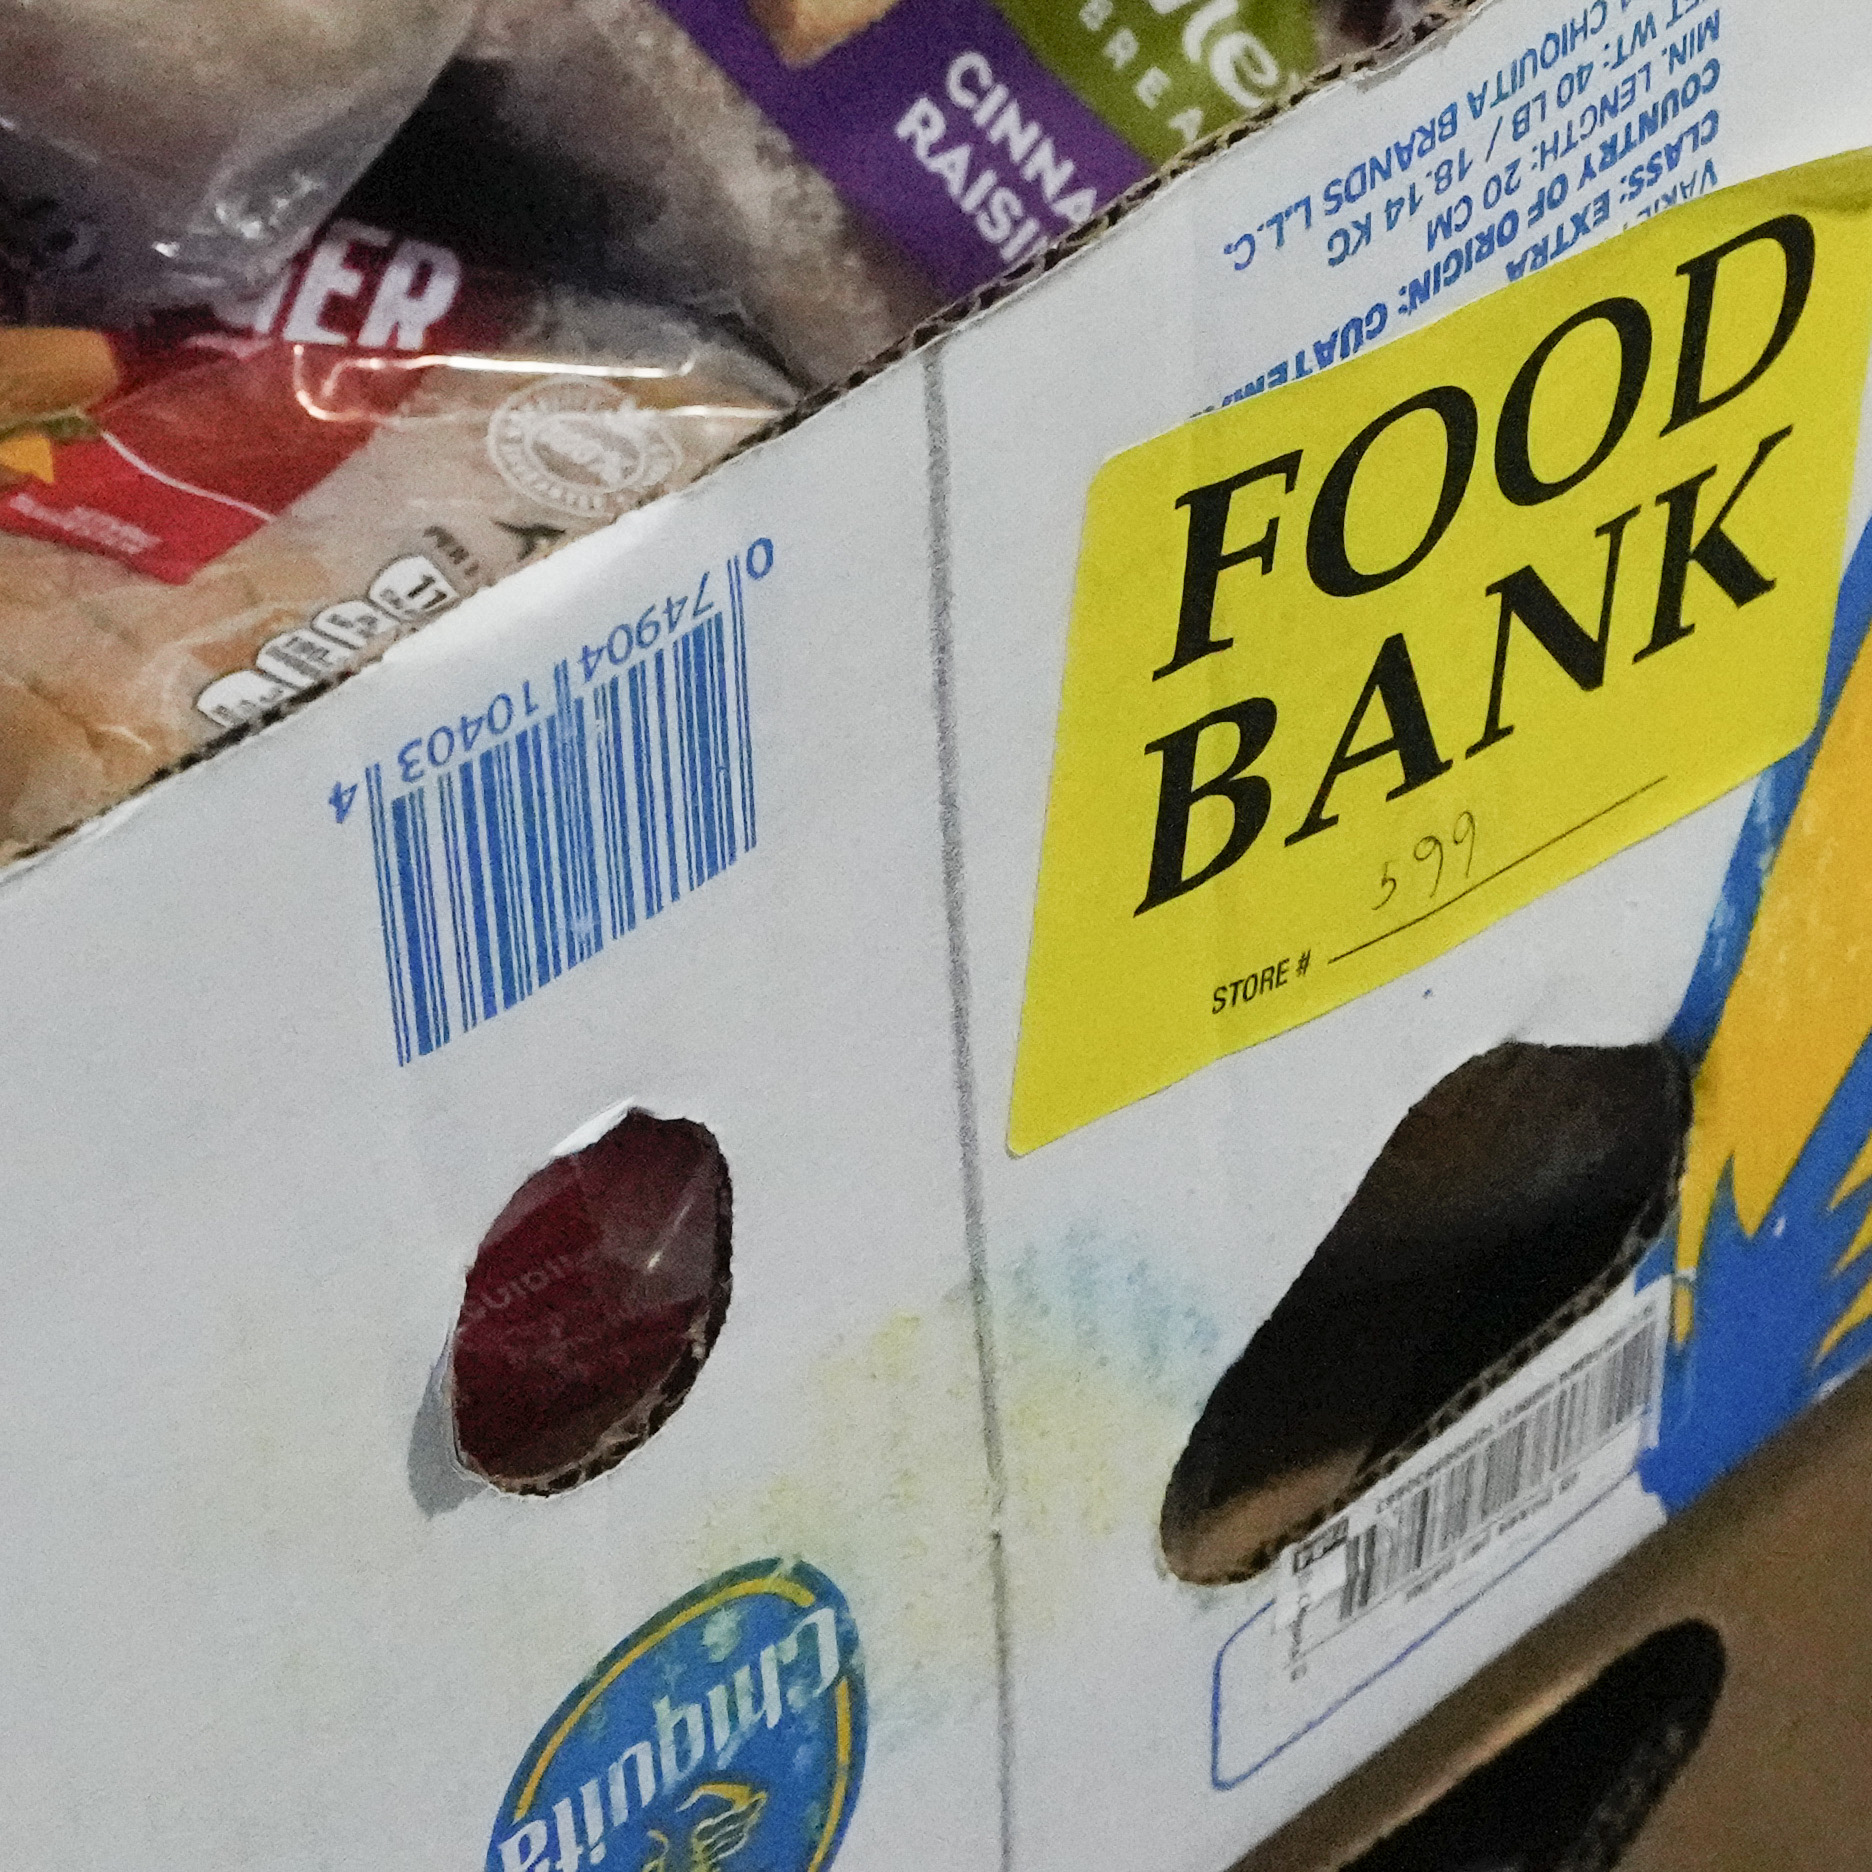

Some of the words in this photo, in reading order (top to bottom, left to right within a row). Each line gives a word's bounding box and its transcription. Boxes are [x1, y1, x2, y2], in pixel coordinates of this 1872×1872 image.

[1555, 67, 1597, 111] 40
[1602, 14, 1660, 72] WT:
[1664, 8, 1723, 78] MIN.
[943, 49, 1100, 231] CINNA
[1321, 102, 1459, 213] BRANDS
[1509, 89, 1549, 144] LB
[1532, 65, 1656, 168] LENGTH:
[1575, 57, 1722, 197] COUNTRY
[1621, 108, 1721, 210] CLASS:
[894, 97, 1054, 264] RAISI
[1425, 200, 1476, 254] CM
[1480, 167, 1524, 212] 20
[1525, 184, 1574, 234] OF
[253, 224, 466, 351] ER
[1395, 208, 1522, 319] ORIGIN:
[1505, 197, 1615, 283] EXTRA
[1152, 211, 1817, 685] FOOD
[748, 536, 776, 582] 0
[576, 568, 716, 685] 74904
[1132, 423, 1796, 918] BANK
[396, 678, 541, 782] 10403
[328, 779, 360, 826] 4
[1368, 808, 1479, 913] 599
[1209, 954, 1292, 1016] STORE
[1294, 948, 1314, 978] #
[496, 1603, 842, 1872] Chiquita
